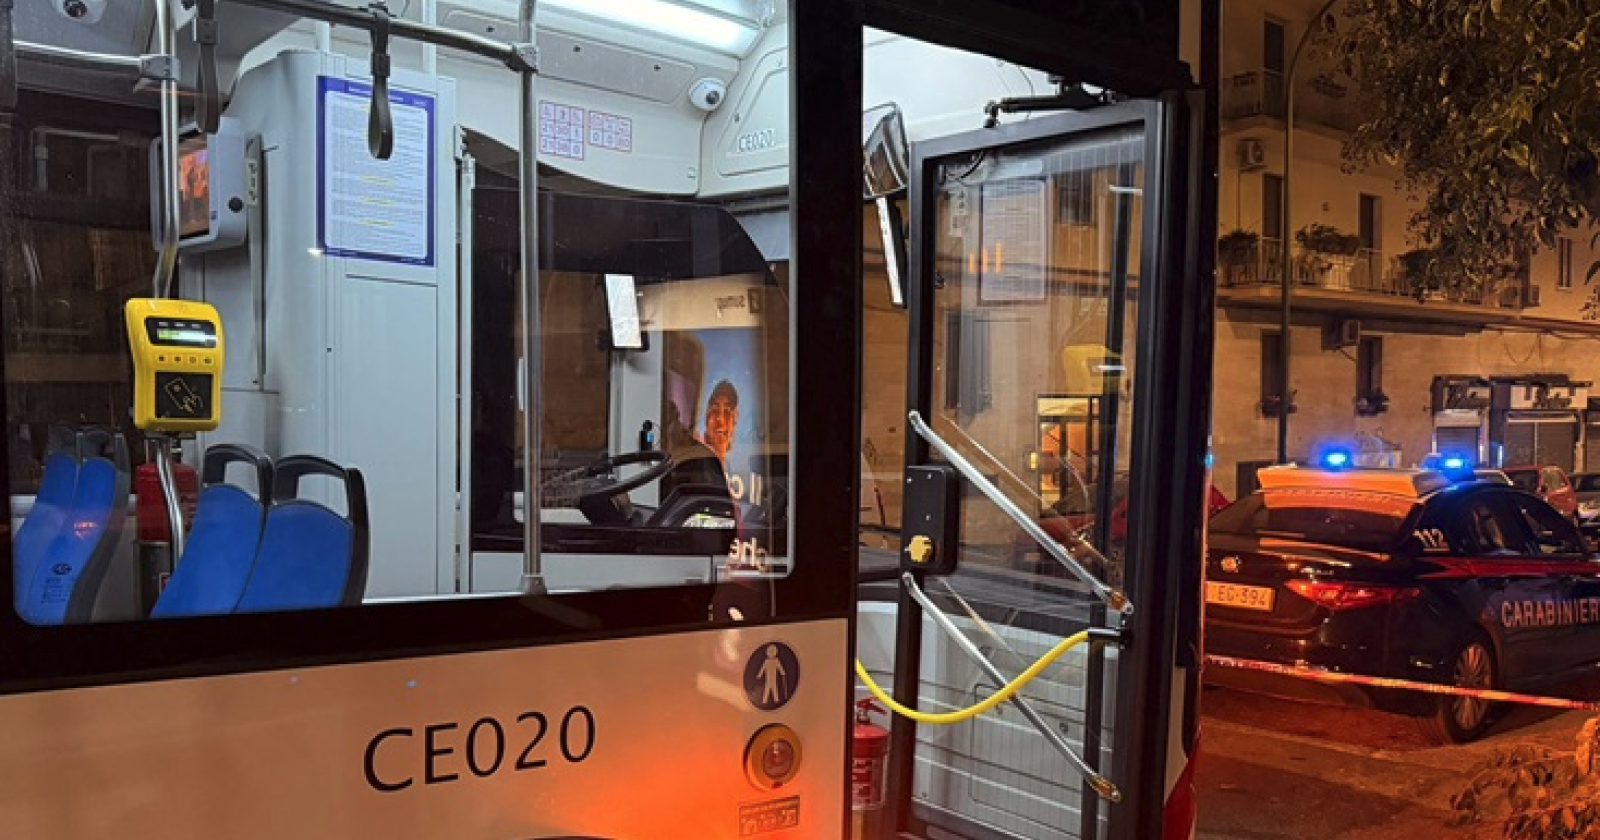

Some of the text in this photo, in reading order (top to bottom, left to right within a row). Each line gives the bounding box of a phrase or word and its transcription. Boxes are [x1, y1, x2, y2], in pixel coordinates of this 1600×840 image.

[738, 129, 774, 153] CE020
[1412, 527, 1448, 549] 112
[362, 704, 597, 793] CE020
